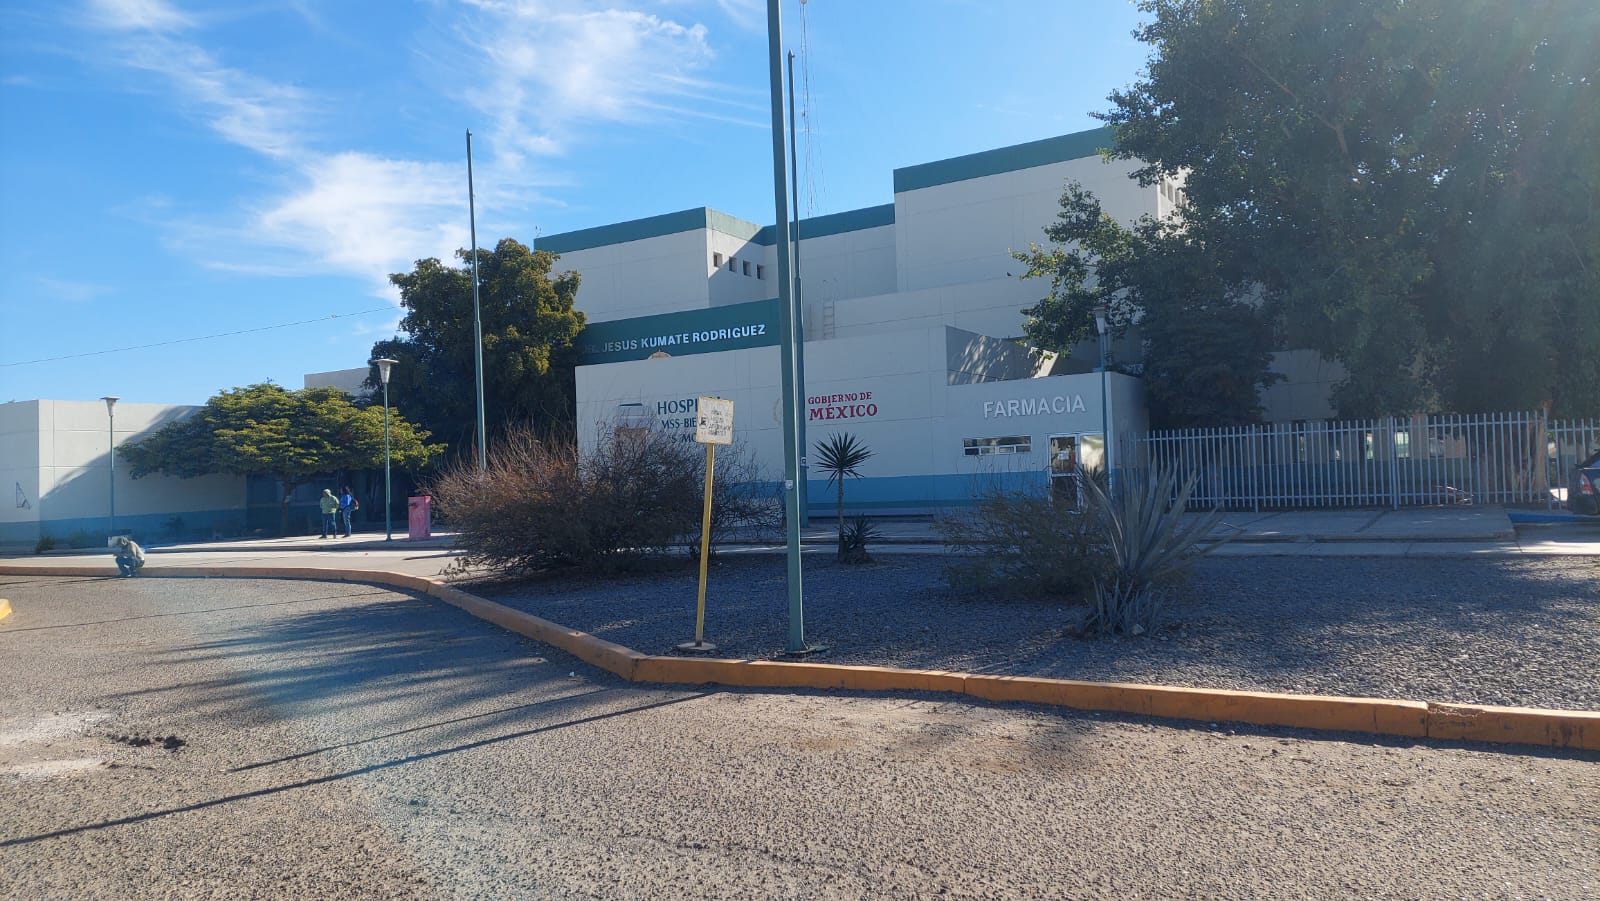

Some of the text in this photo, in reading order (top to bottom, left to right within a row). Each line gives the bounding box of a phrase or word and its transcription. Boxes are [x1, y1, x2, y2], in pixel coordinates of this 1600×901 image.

[603, 340, 637, 353] JESUS
[641, 333, 689, 348] KUMATE
[692, 324, 765, 342] RODRIGUEZ
[808, 391, 872, 404] GOBIERNO DE
[983, 394, 1086, 418] FARMACIA
[657, 398, 698, 415] HOSPI
[809, 404, 877, 420] MÉXICO
